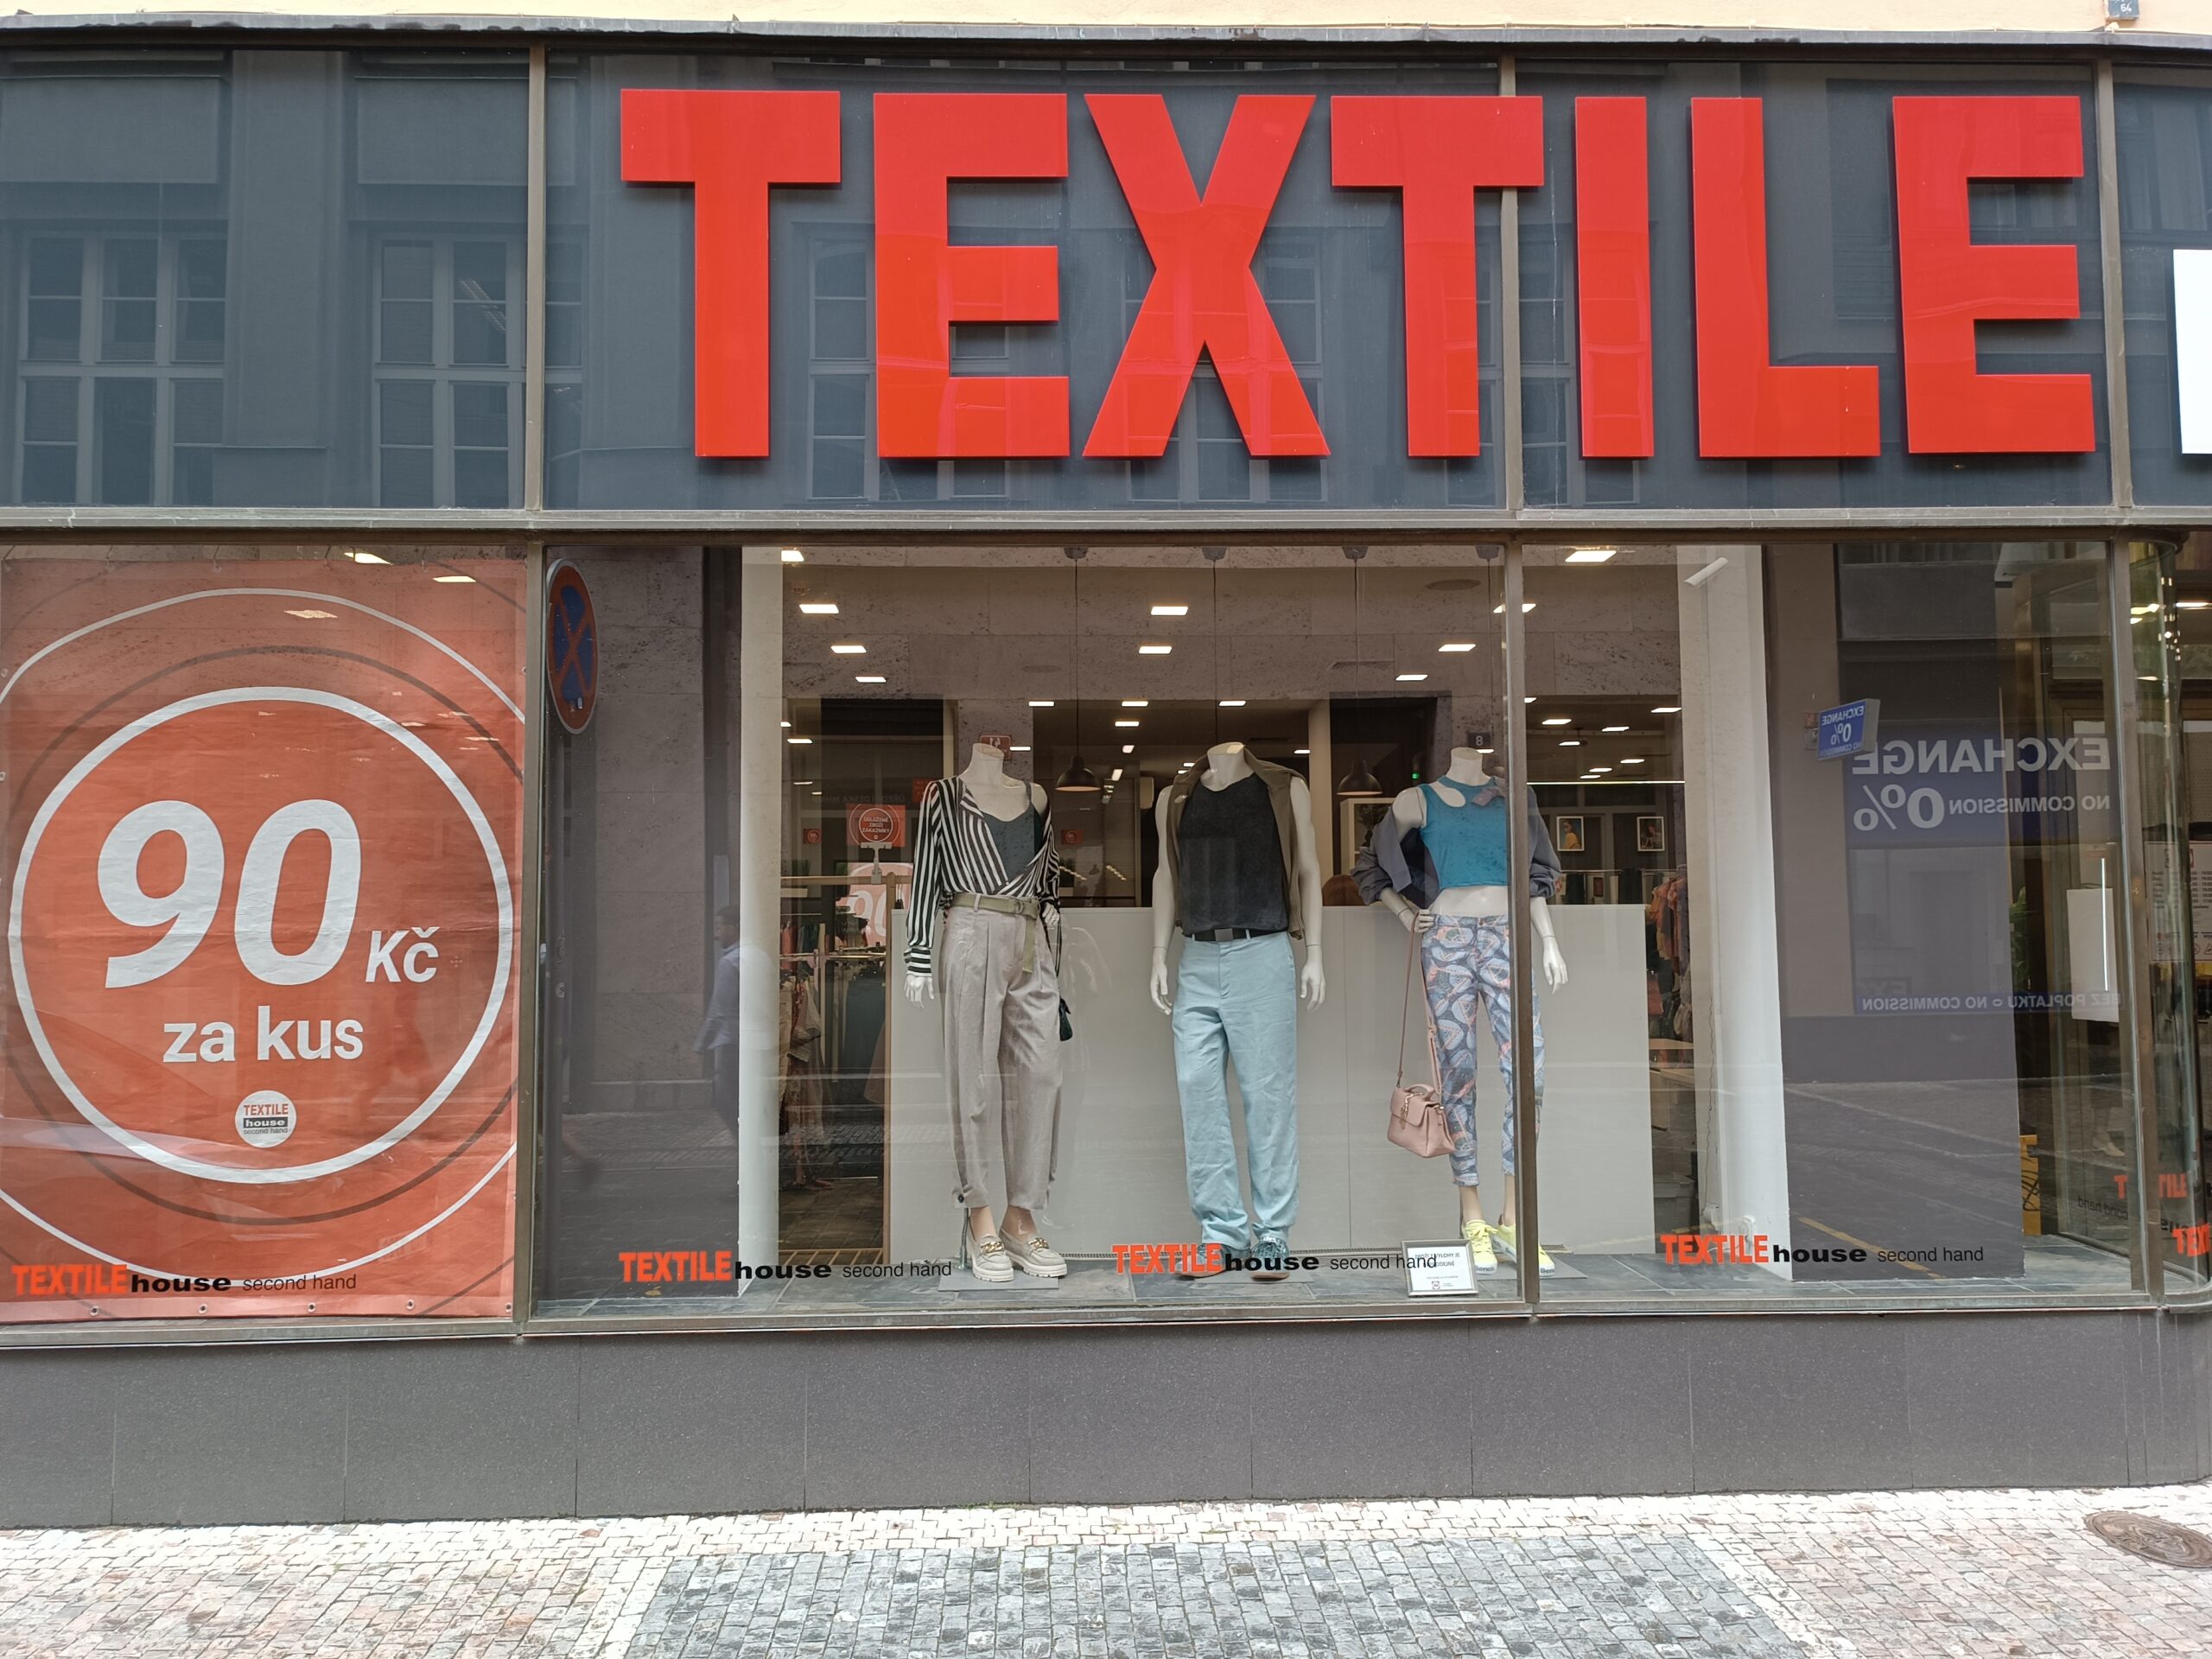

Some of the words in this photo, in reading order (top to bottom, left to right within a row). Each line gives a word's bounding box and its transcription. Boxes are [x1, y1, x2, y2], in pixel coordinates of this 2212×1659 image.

[620, 88, 2096, 458] TEXTILE
[98, 799, 361, 988] 90
[365, 927, 440, 982] Kč
[162, 1020, 236, 1063] za
[258, 1006, 364, 1060] kus
[243, 1103, 289, 1116] TEXTILE
[619, 1250, 732, 1282] TEXTILE
[735, 1262, 831, 1279] house
[842, 1262, 903, 1278] second
[910, 1262, 951, 1277] hand
[1112, 1243, 1224, 1274] TEXTILE
[1225, 1254, 1319, 1271] house
[1330, 1253, 1389, 1270] second
[1396, 1253, 1437, 1268] hand
[1659, 1235, 1769, 1265] TEXTILE
[1773, 1244, 1867, 1262] house
[1877, 1247, 1937, 1262] second
[1943, 1246, 1984, 1262] hand
[11, 1263, 128, 1295] TEXTILE
[131, 1274, 232, 1293] house
[243, 1274, 306, 1291] second
[314, 1274, 357, 1290] hand
